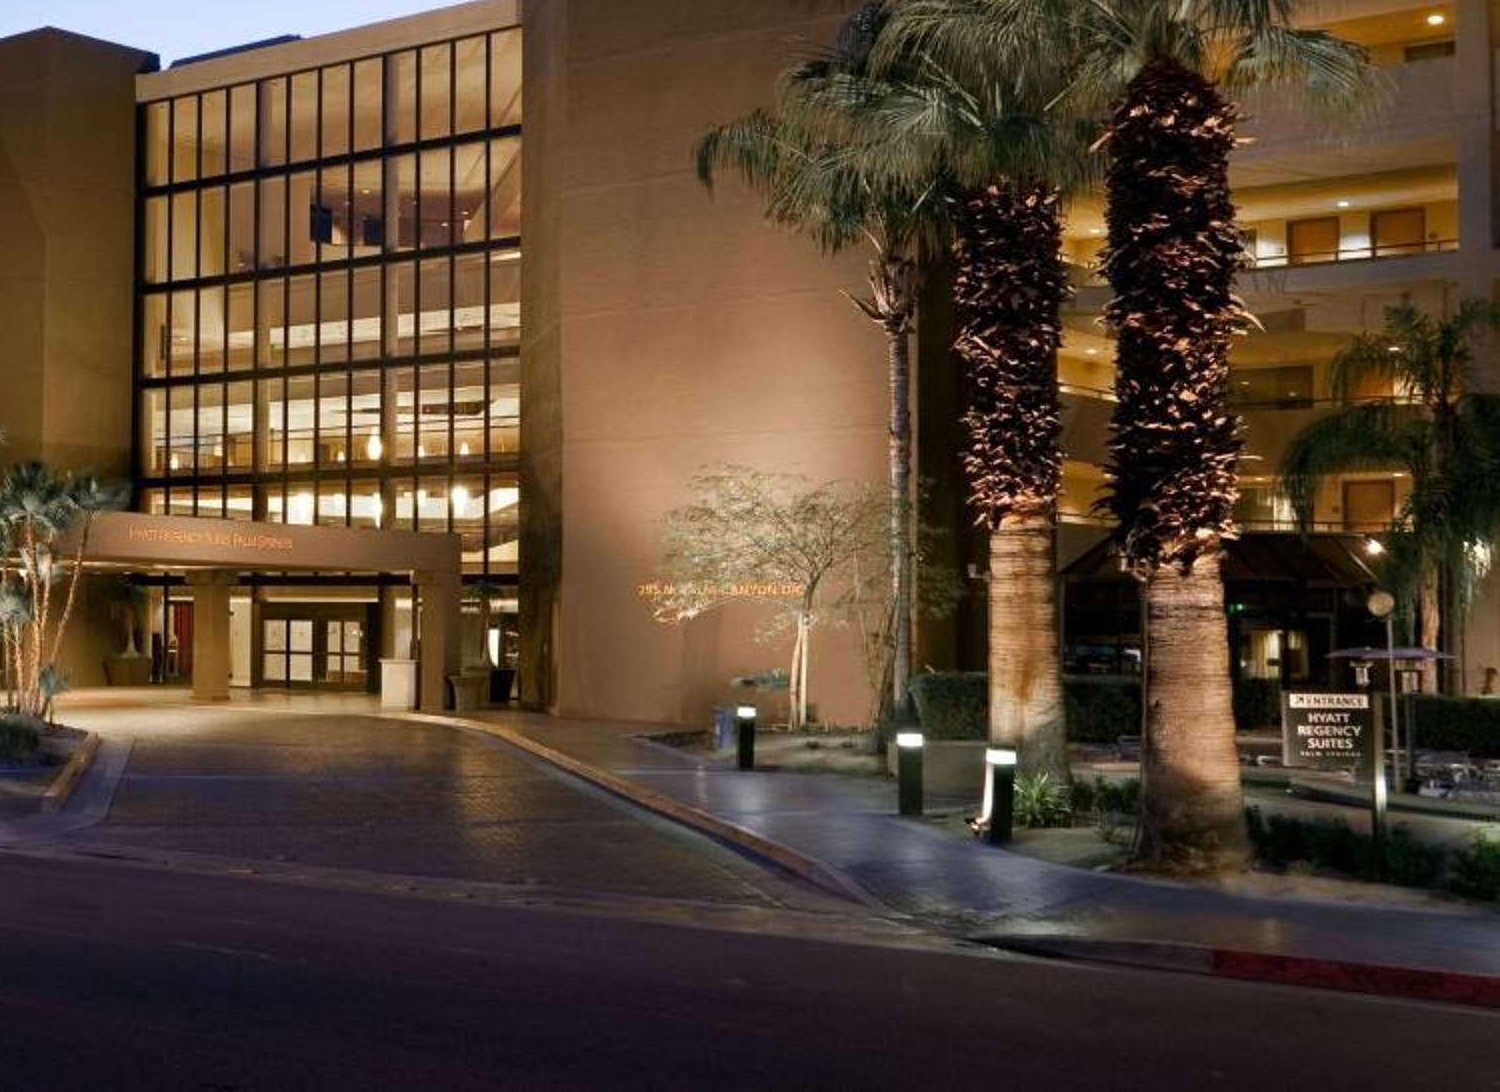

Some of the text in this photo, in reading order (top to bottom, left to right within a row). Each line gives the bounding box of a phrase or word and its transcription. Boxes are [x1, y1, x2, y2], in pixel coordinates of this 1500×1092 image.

[722, 583, 778, 597] ANYON
[1306, 695, 1364, 706] ENTRANCE
[1307, 712, 1350, 724] HYATT
[1297, 725, 1362, 737] REGENCY
[1307, 737, 1354, 749] SUITES
